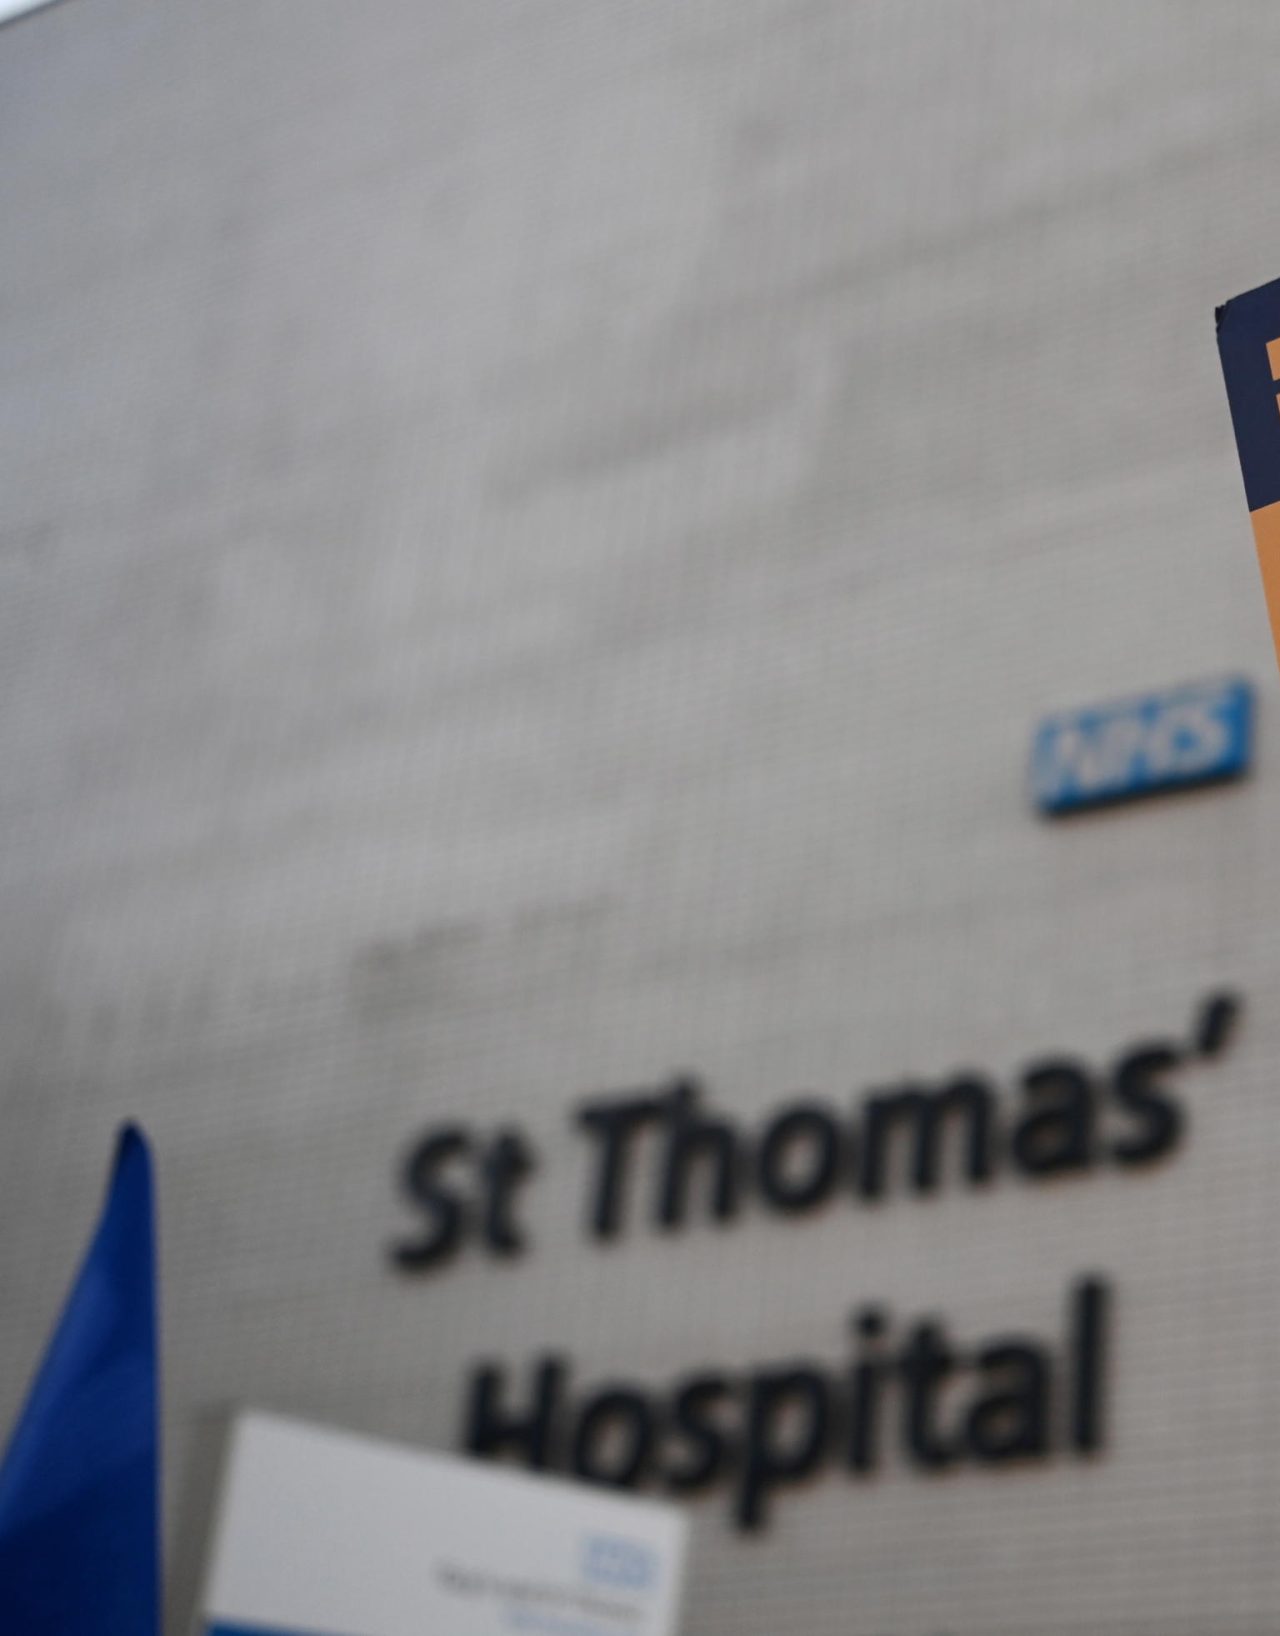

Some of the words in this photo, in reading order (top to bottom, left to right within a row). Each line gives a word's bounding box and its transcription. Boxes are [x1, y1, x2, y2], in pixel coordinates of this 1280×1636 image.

[1032, 698, 1230, 796] NHS
[388, 1121, 537, 1273] St
[463, 1271, 1112, 1537] Hospital
